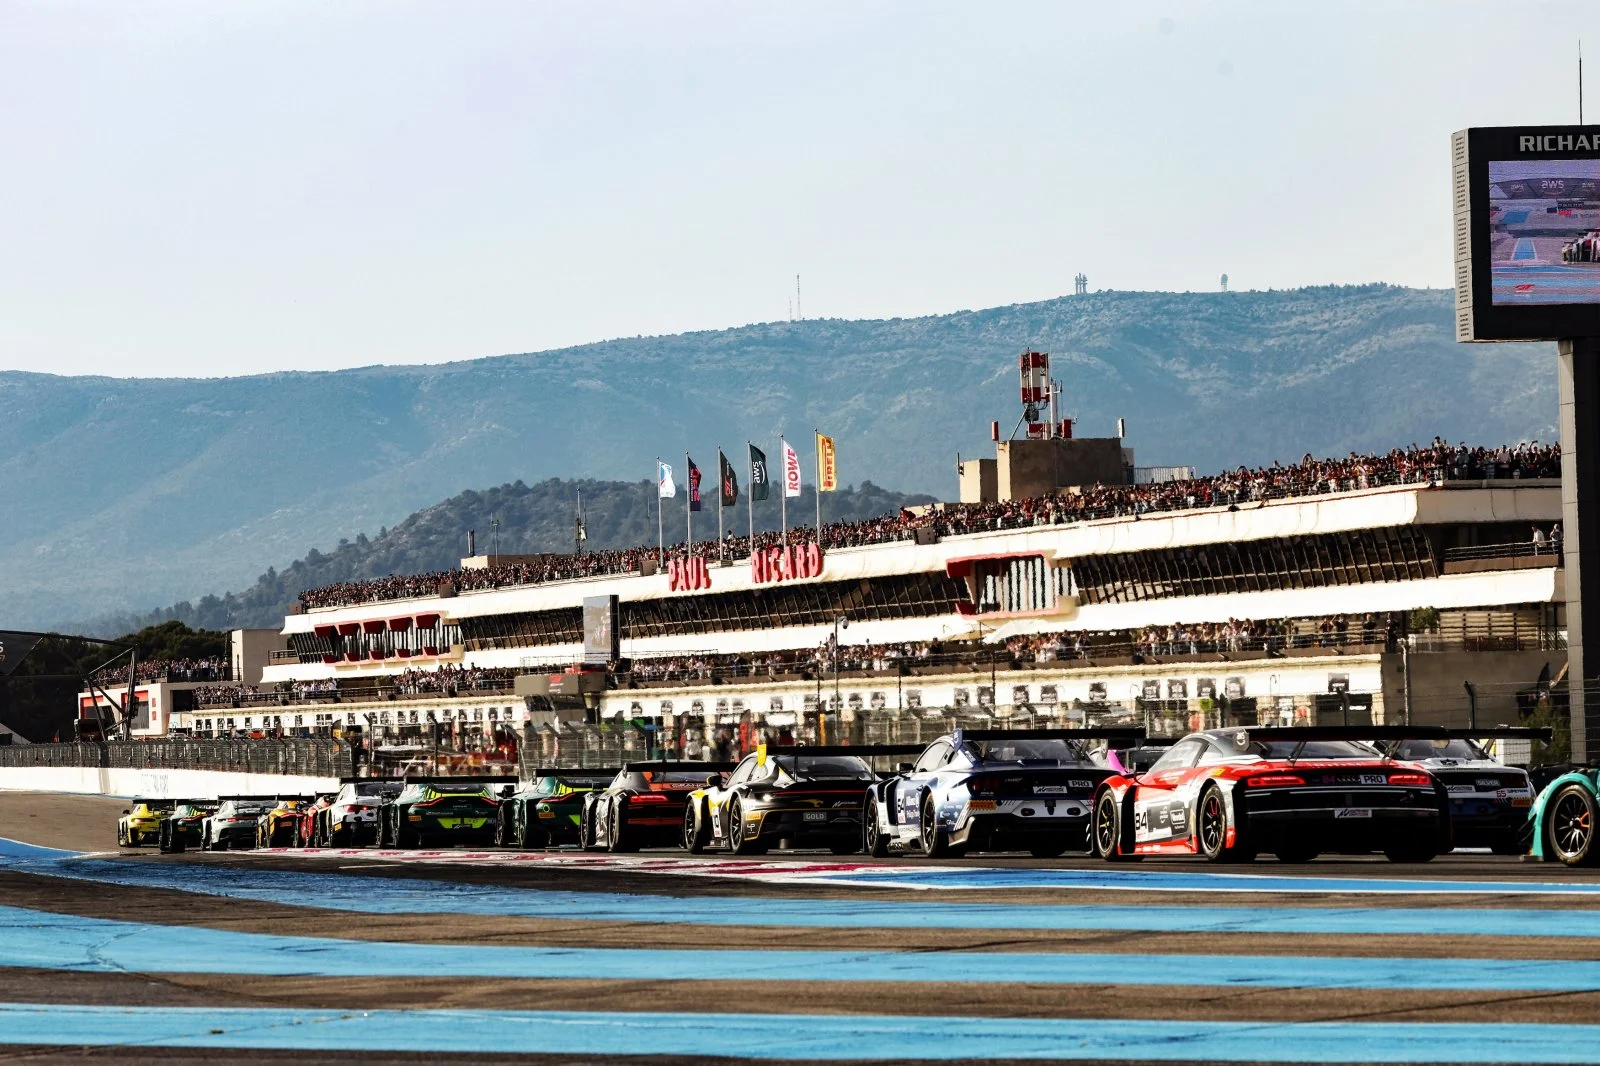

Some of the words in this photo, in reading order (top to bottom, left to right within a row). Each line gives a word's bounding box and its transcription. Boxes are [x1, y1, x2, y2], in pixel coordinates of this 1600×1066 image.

[1541, 180, 1564, 189] aws
[753, 461, 761, 484] aws
[668, 556, 712, 592] PAUL
[752, 543, 824, 584] RICARD
[1364, 775, 1383, 784] PRO
[1496, 790, 1506, 798] 65
